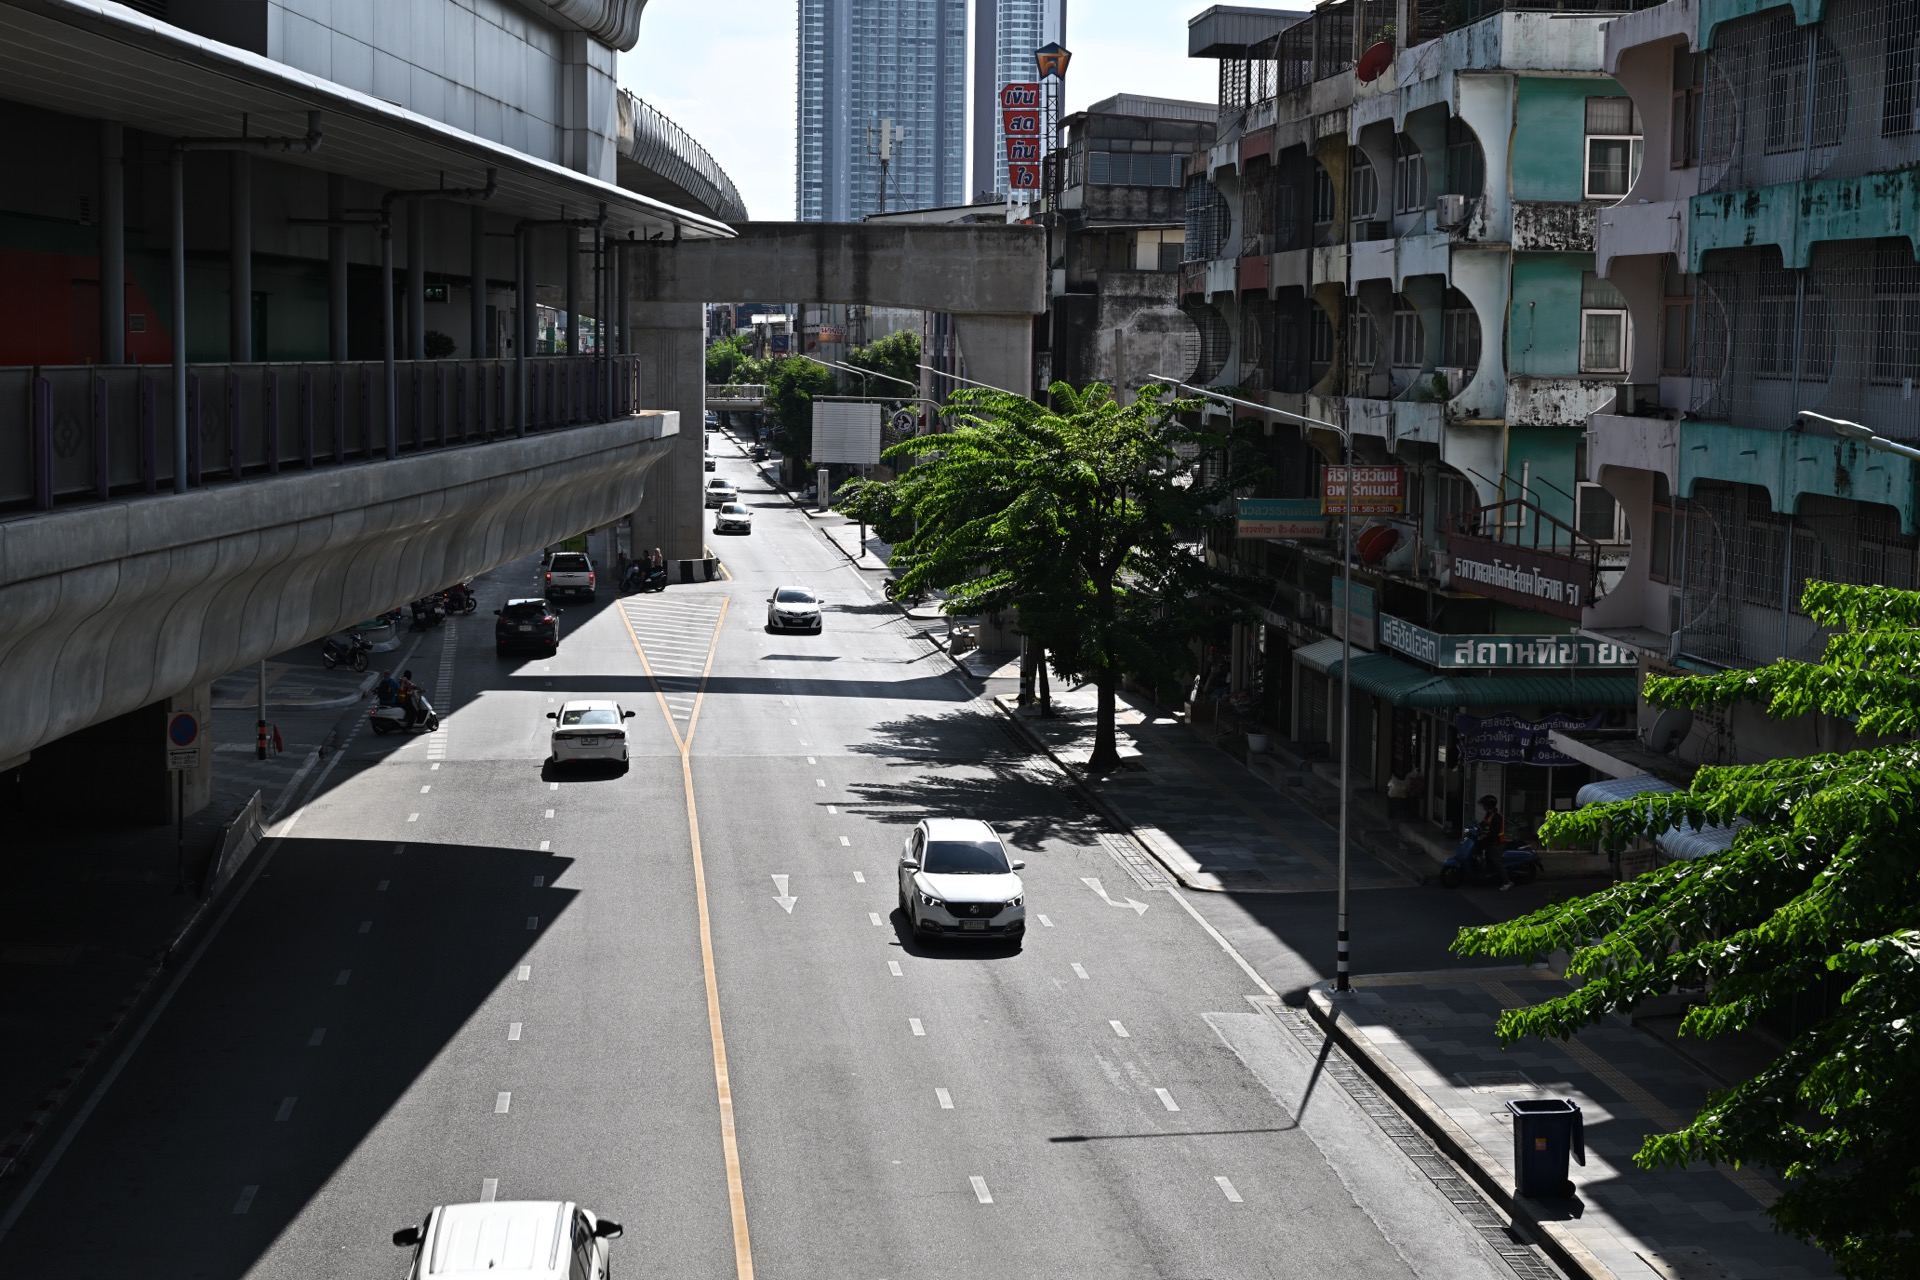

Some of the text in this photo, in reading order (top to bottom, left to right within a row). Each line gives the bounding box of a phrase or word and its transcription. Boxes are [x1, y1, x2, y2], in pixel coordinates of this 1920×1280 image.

[1005, 86, 1036, 105] เงิน
[1009, 116, 1035, 131] สด
[1011, 140, 1036, 159] ทัน
[1017, 167, 1034, 186] ใจ
[1327, 483, 1399, 496] อพร์ทเมนต์
